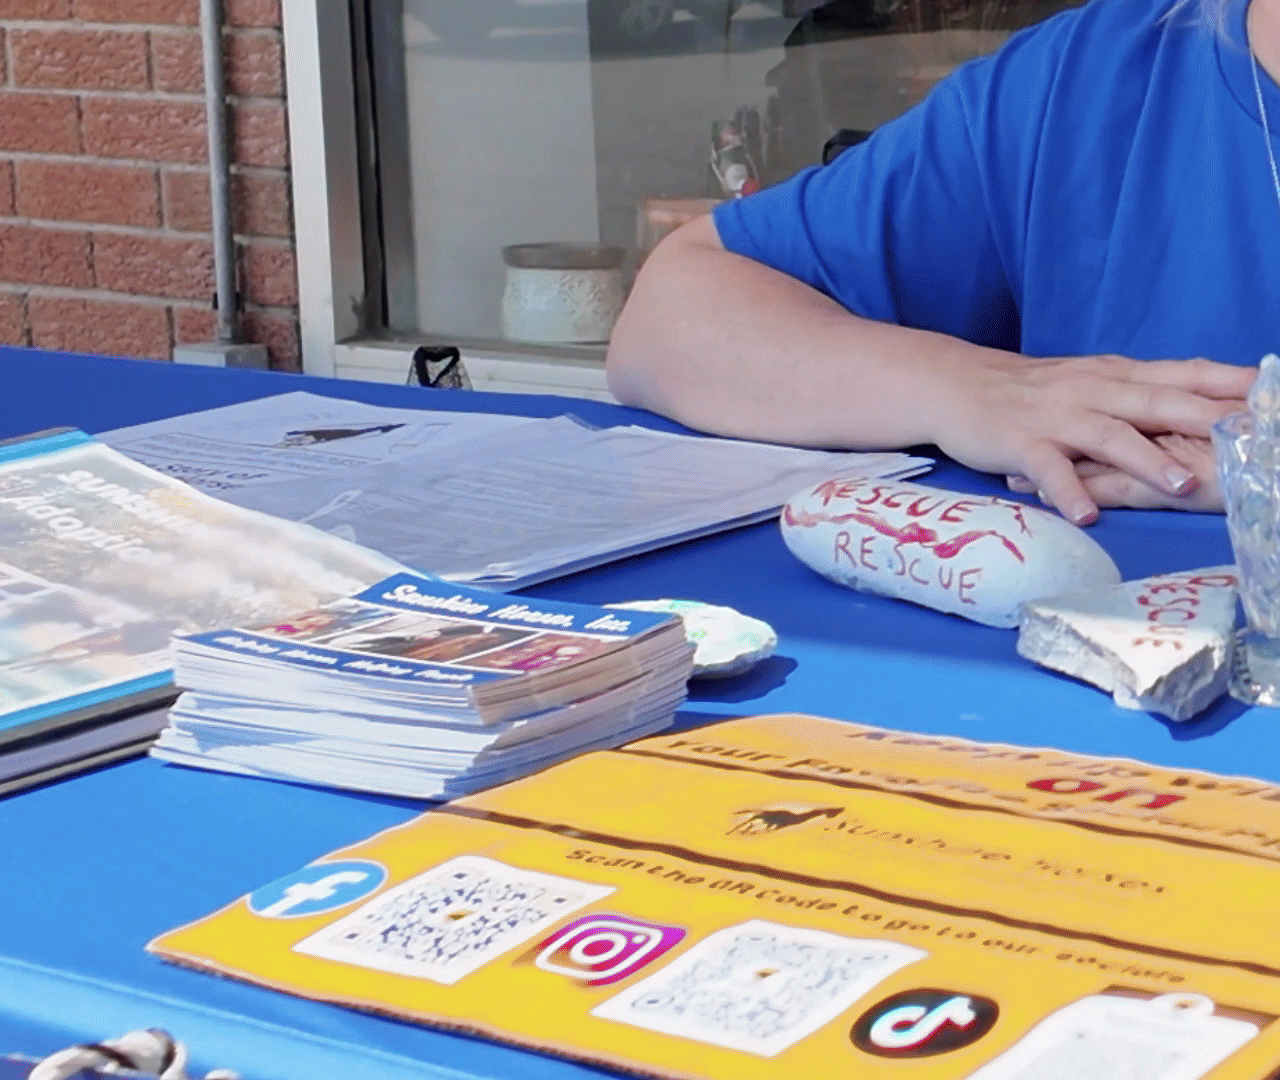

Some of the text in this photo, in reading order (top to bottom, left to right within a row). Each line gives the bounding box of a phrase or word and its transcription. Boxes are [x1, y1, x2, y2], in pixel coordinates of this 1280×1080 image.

[834, 530, 984, 606] RESCUE
[566, 849, 645, 870] Scan
[646, 865, 706, 885] the
[755, 888, 838, 911] Code
[842, 904, 882, 921] to
